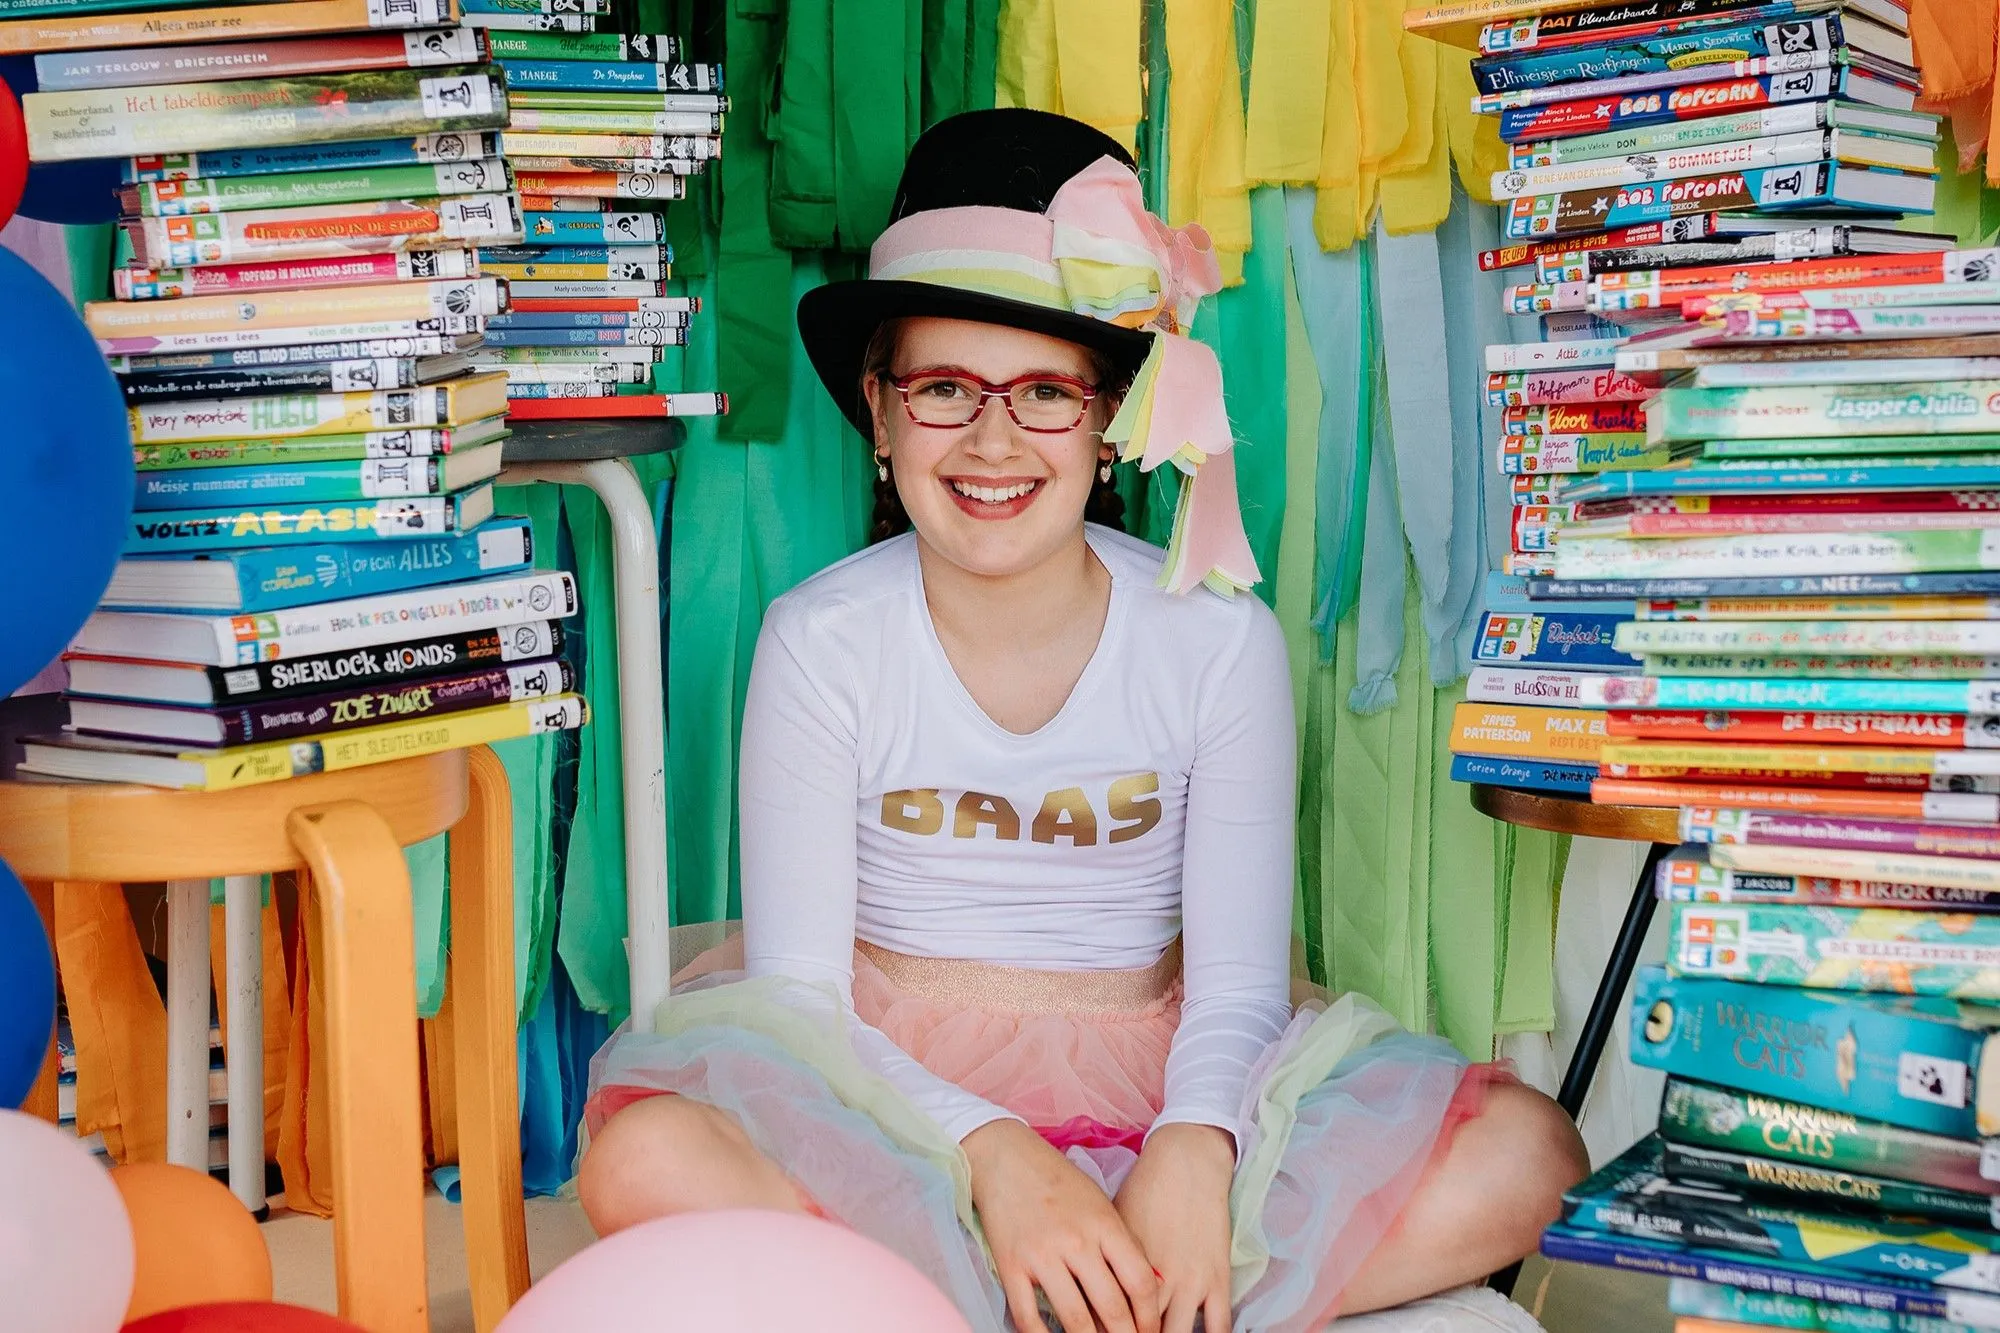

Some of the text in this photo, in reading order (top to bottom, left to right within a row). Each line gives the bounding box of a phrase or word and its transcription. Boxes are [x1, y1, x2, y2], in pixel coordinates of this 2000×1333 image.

[142, 16, 242, 34] Alleen maar zee
[490, 39, 528, 51] MANEGE
[63, 53, 268, 76] JAN TERLOUW BRIEFGEHEIM
[1488, 55, 1651, 91] Elfmeisje en Raafjongen
[520, 70, 559, 81] MANEGE
[126, 97, 157, 114] Het
[1619, 93, 1662, 117] BOB
[1566, 112, 1592, 123] Linden
[1616, 138, 1637, 150] DON
[1668, 144, 1752, 170] BOMMETJE!
[1617, 187, 1654, 209] BOB
[1566, 208, 1590, 219] Linden
[1642, 200, 1700, 216] MEESTERKOK
[1512, 247, 1527, 261] UFO
[1533, 242, 1556, 256] ALIEN
[1557, 241, 1567, 252] IN
[1582, 234, 1608, 249] SPITS
[173, 336, 197, 346] lees
[205, 334, 229, 343] lees
[259, 346, 288, 365] mop
[290, 345, 313, 361] met
[315, 343, 338, 359] een
[1556, 348, 1579, 361] Actie
[147, 479, 190, 495] Meisje
[192, 477, 248, 492] nummer
[135, 518, 221, 540] WOLTZ
[398, 542, 453, 572] ALLES
[270, 651, 383, 690] SHERLOCK
[383, 643, 457, 674] HONDS
[1514, 680, 1561, 698] BLOSSOM
[1481, 714, 1517, 728] JAMES
[1546, 717, 1586, 735] MAX
[1463, 727, 1532, 743] PATTERSON
[336, 741, 361, 761] HET
[1467, 761, 1496, 775] Corien
[1732, 1035, 1807, 1080] CATS
[1762, 1119, 1835, 1158] CATS
